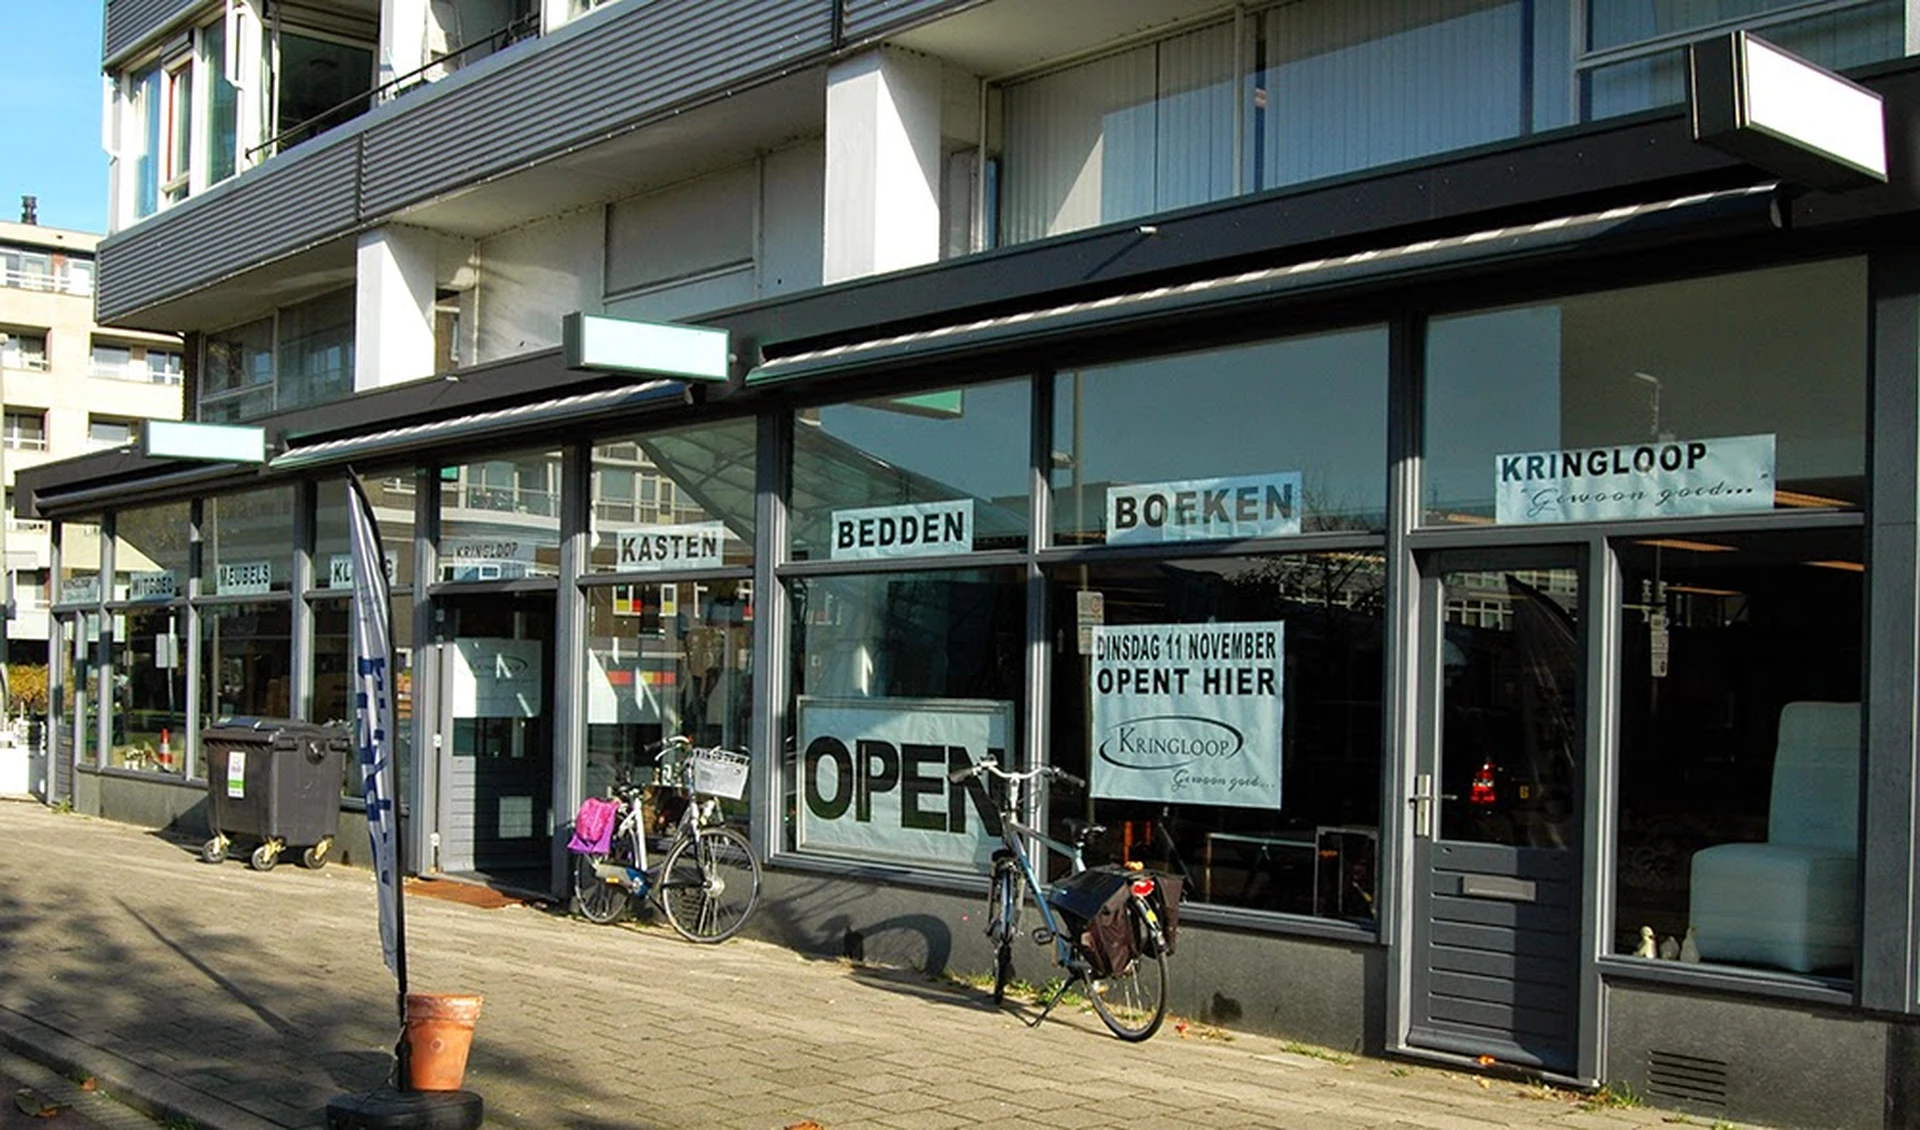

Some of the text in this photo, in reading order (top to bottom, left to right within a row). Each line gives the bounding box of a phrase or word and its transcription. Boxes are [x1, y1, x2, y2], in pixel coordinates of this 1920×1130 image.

[1502, 442, 1707, 482] KRINGLOOP
[1115, 483, 1292, 529] BOEKEN
[837, 511, 964, 549] BEDDEN
[620, 535, 717, 563] KASTEN
[219, 564, 269, 586] MEUBELS
[1097, 631, 1276, 660] DINSDAG 11 NOVEMBER
[1097, 667, 1276, 695] OPENT HIER
[1118, 726, 1230, 757] KRINGLOOP
[804, 735, 1006, 837] OPEN
